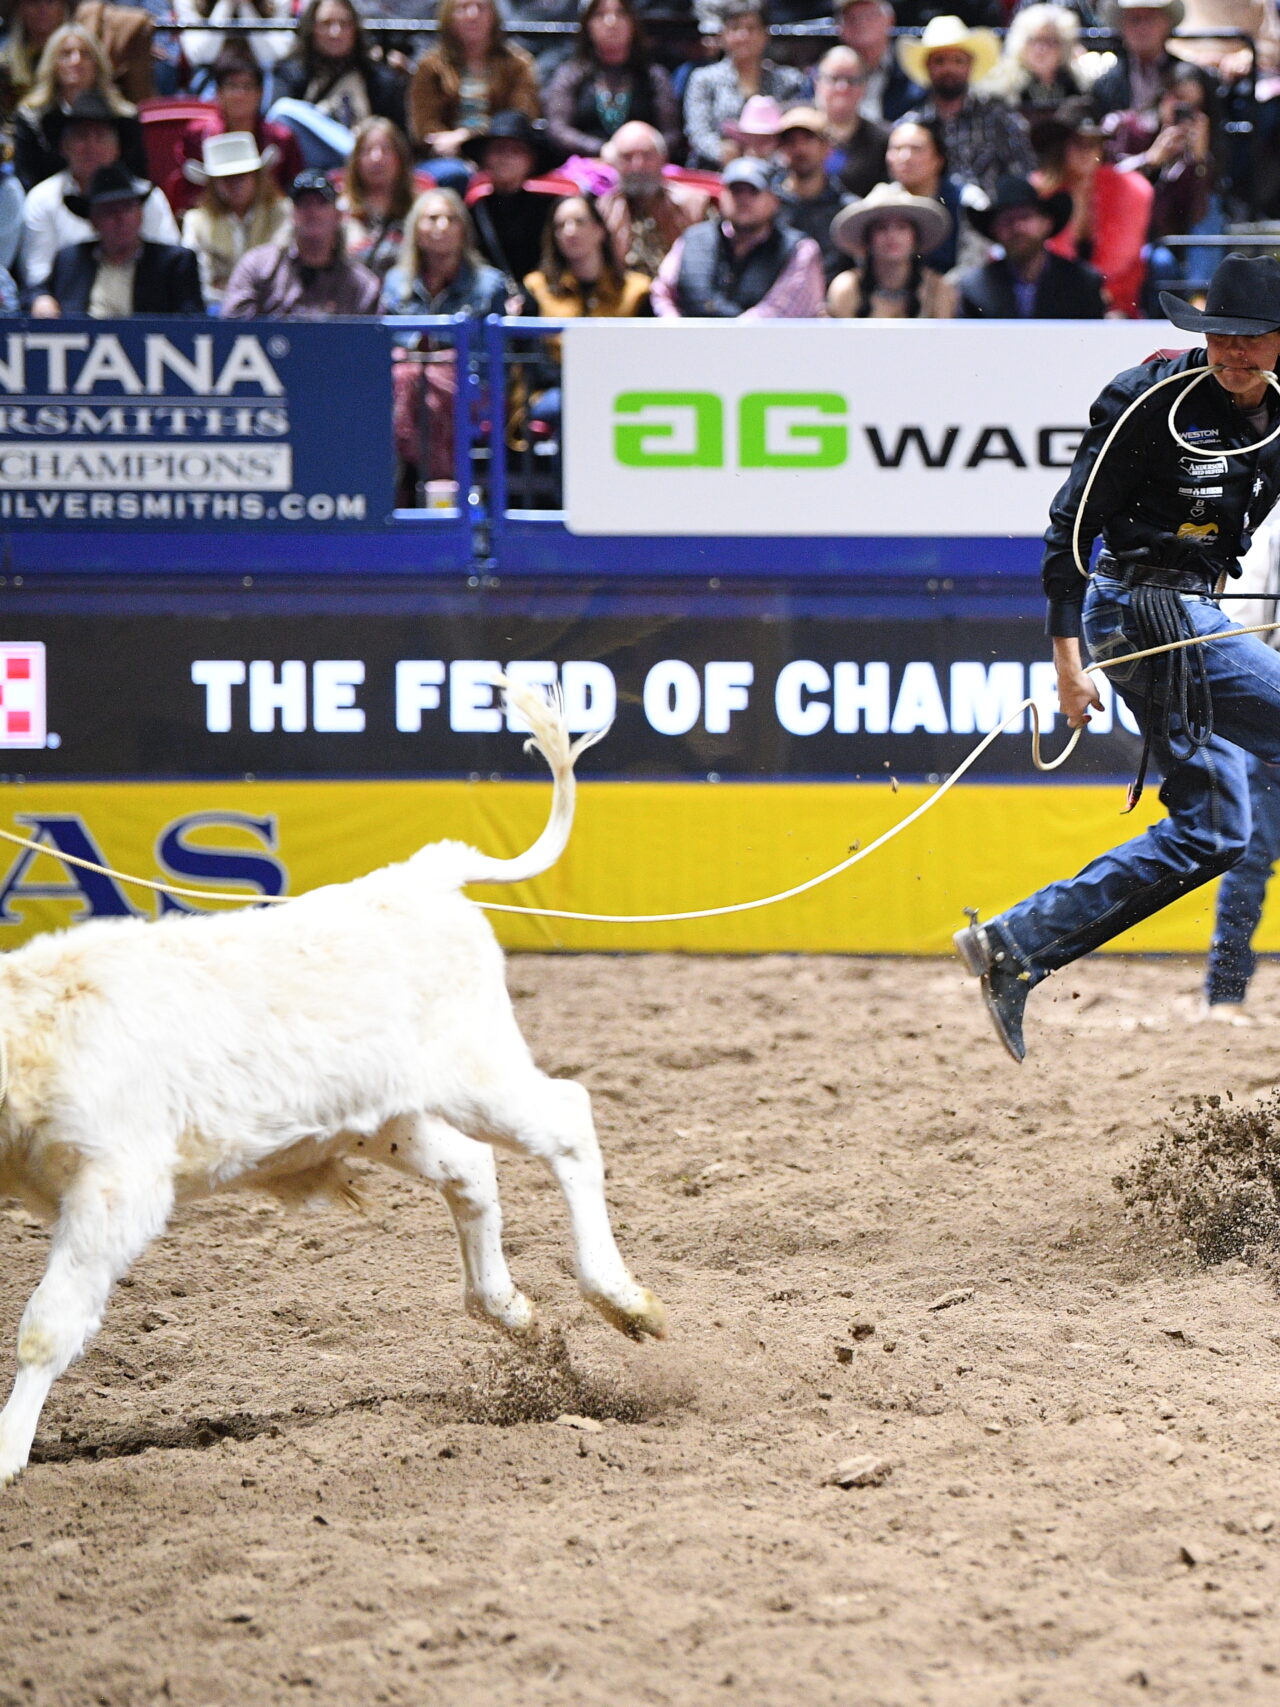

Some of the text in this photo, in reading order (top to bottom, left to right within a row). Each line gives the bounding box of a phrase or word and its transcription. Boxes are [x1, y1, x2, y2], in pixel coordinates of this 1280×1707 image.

[191, 659, 366, 733] THE
[395, 659, 617, 733] FEED
[643, 658, 755, 736] OF
